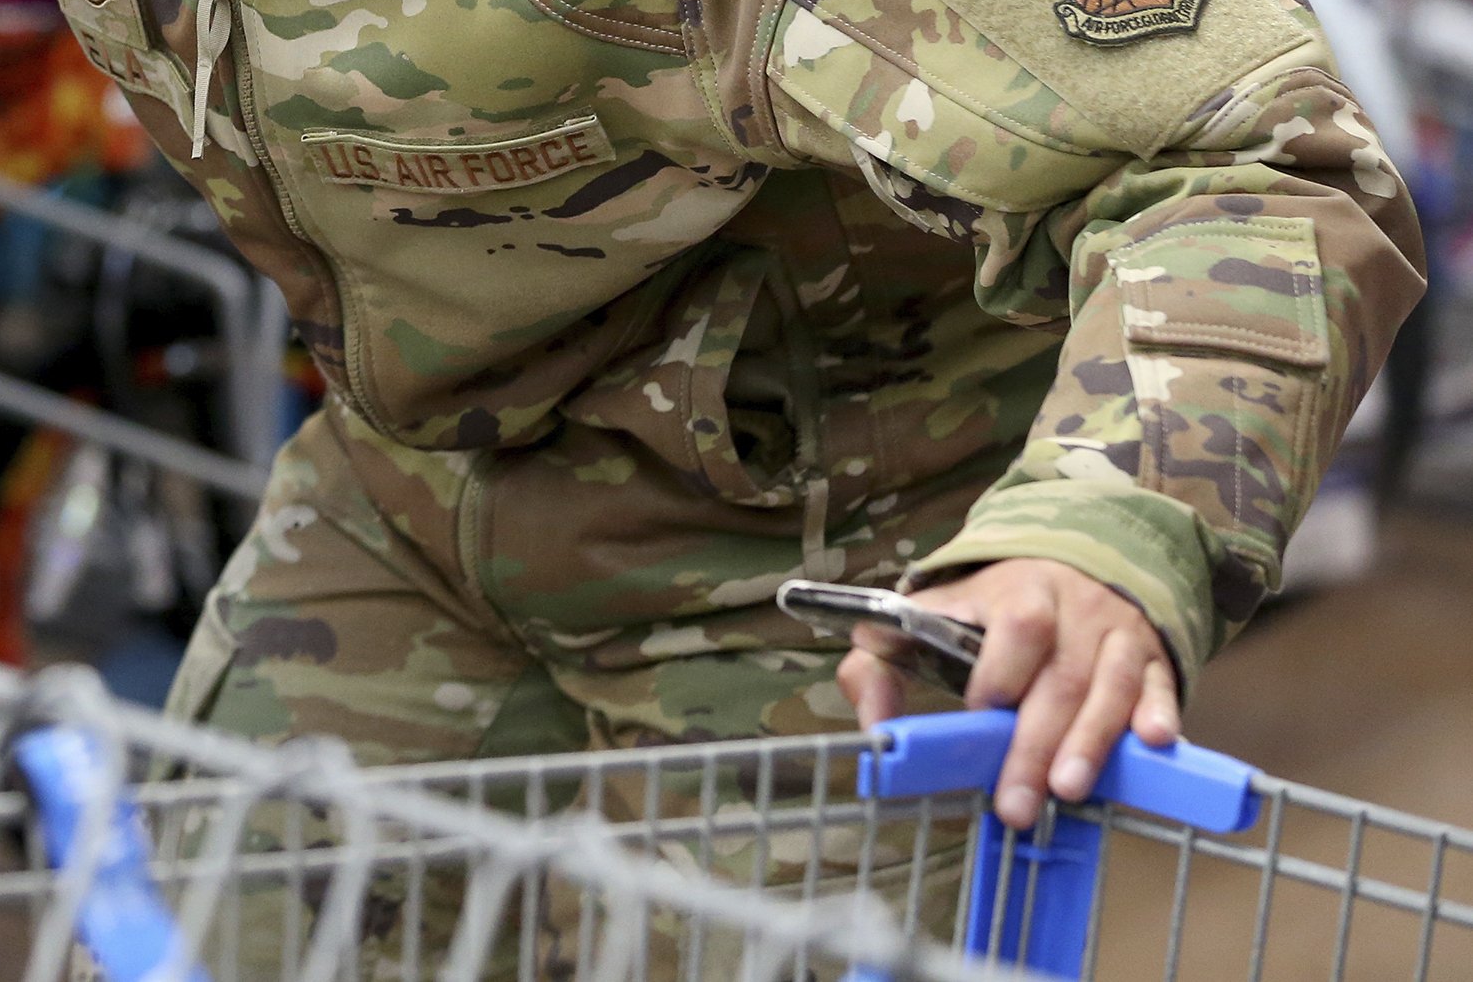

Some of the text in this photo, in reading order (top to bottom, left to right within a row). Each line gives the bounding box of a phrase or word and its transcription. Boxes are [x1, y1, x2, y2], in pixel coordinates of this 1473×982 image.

[320, 130, 598, 189] U.S. AIR FORCE
